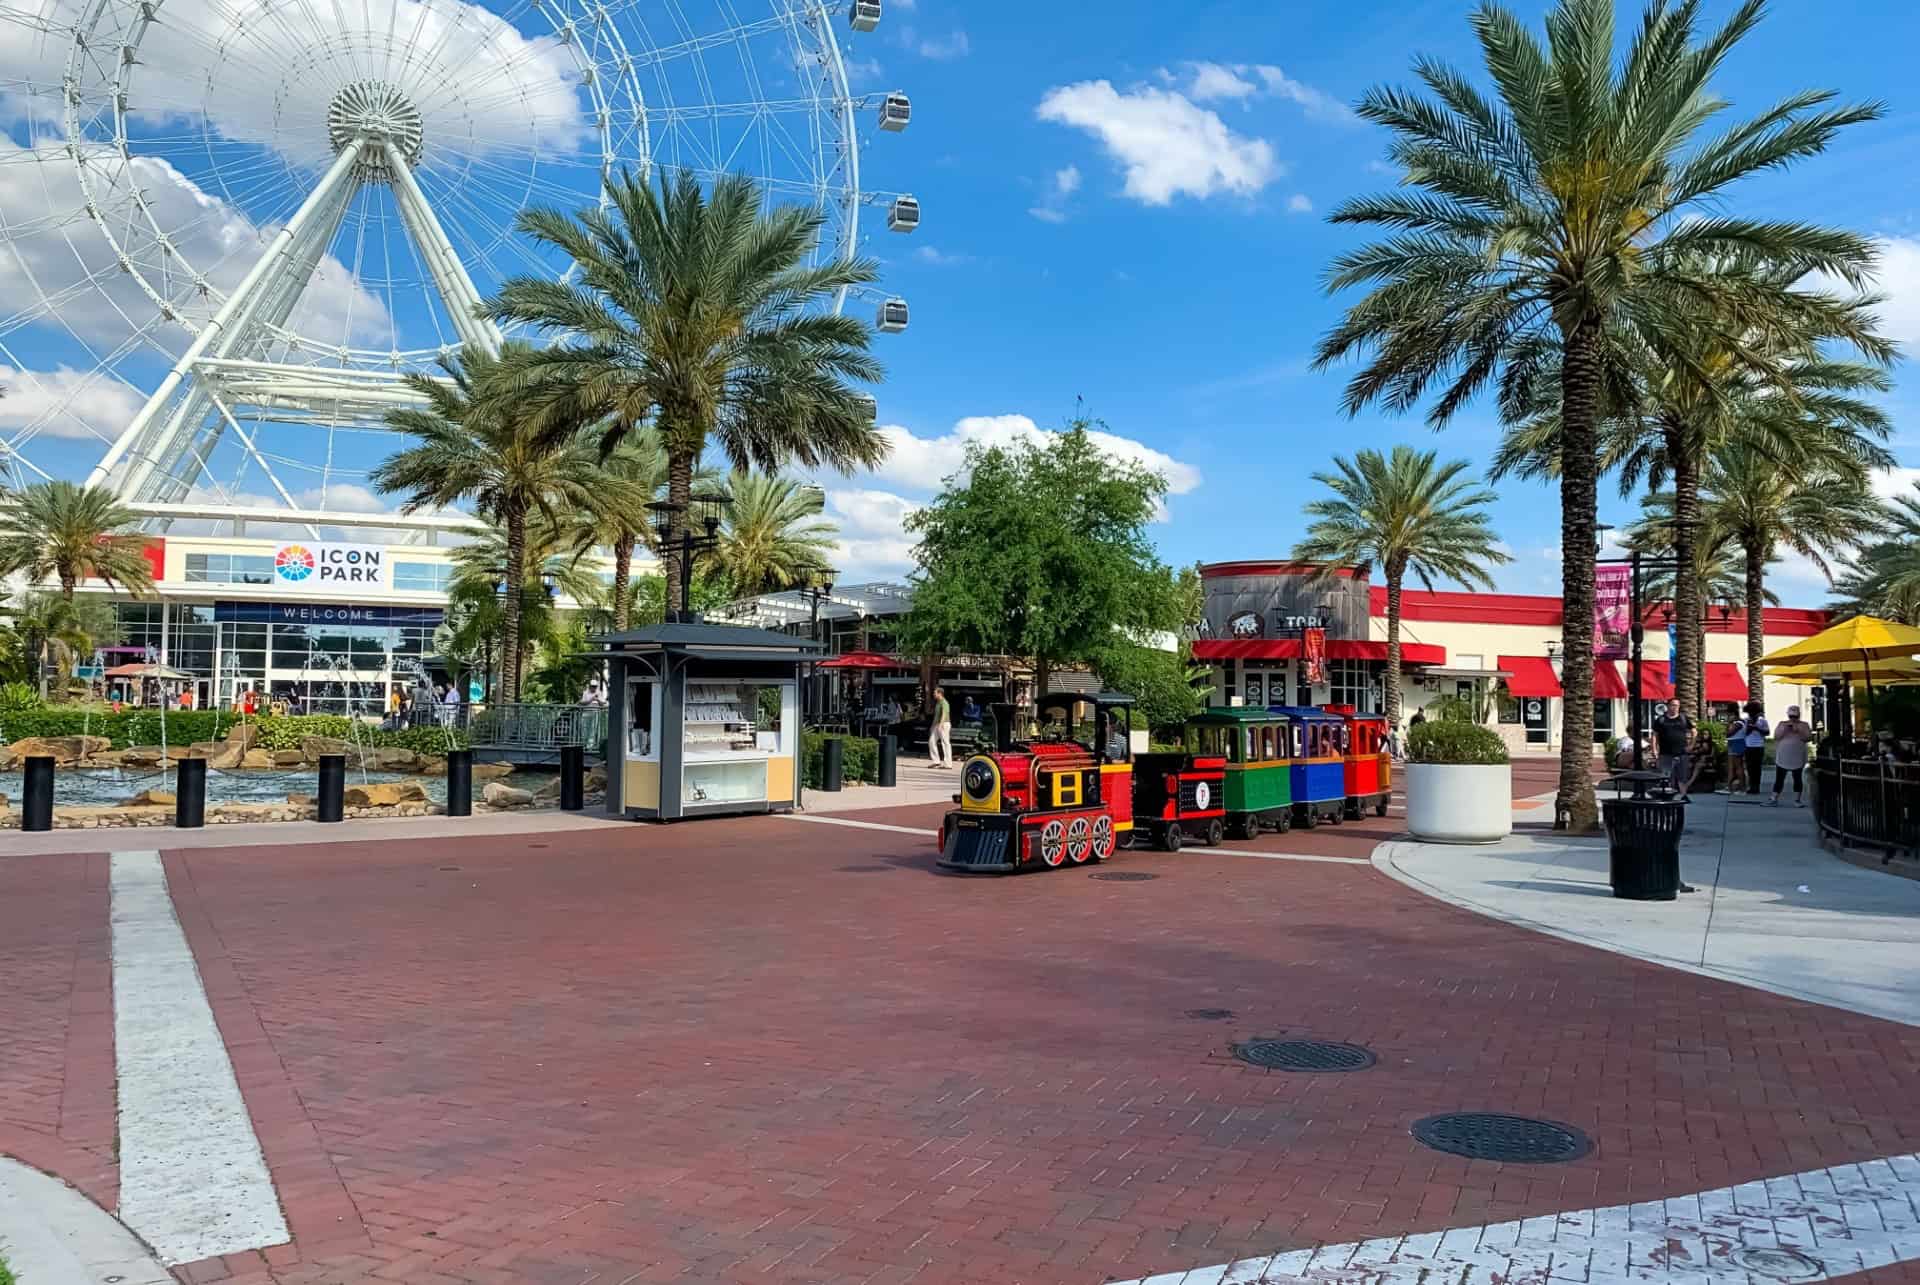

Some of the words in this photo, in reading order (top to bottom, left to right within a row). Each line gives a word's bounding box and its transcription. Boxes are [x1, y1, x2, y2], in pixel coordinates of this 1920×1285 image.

[321, 549, 380, 565] ICON
[320, 567, 379, 582] PARK
[283, 607, 374, 620] WELCOME
